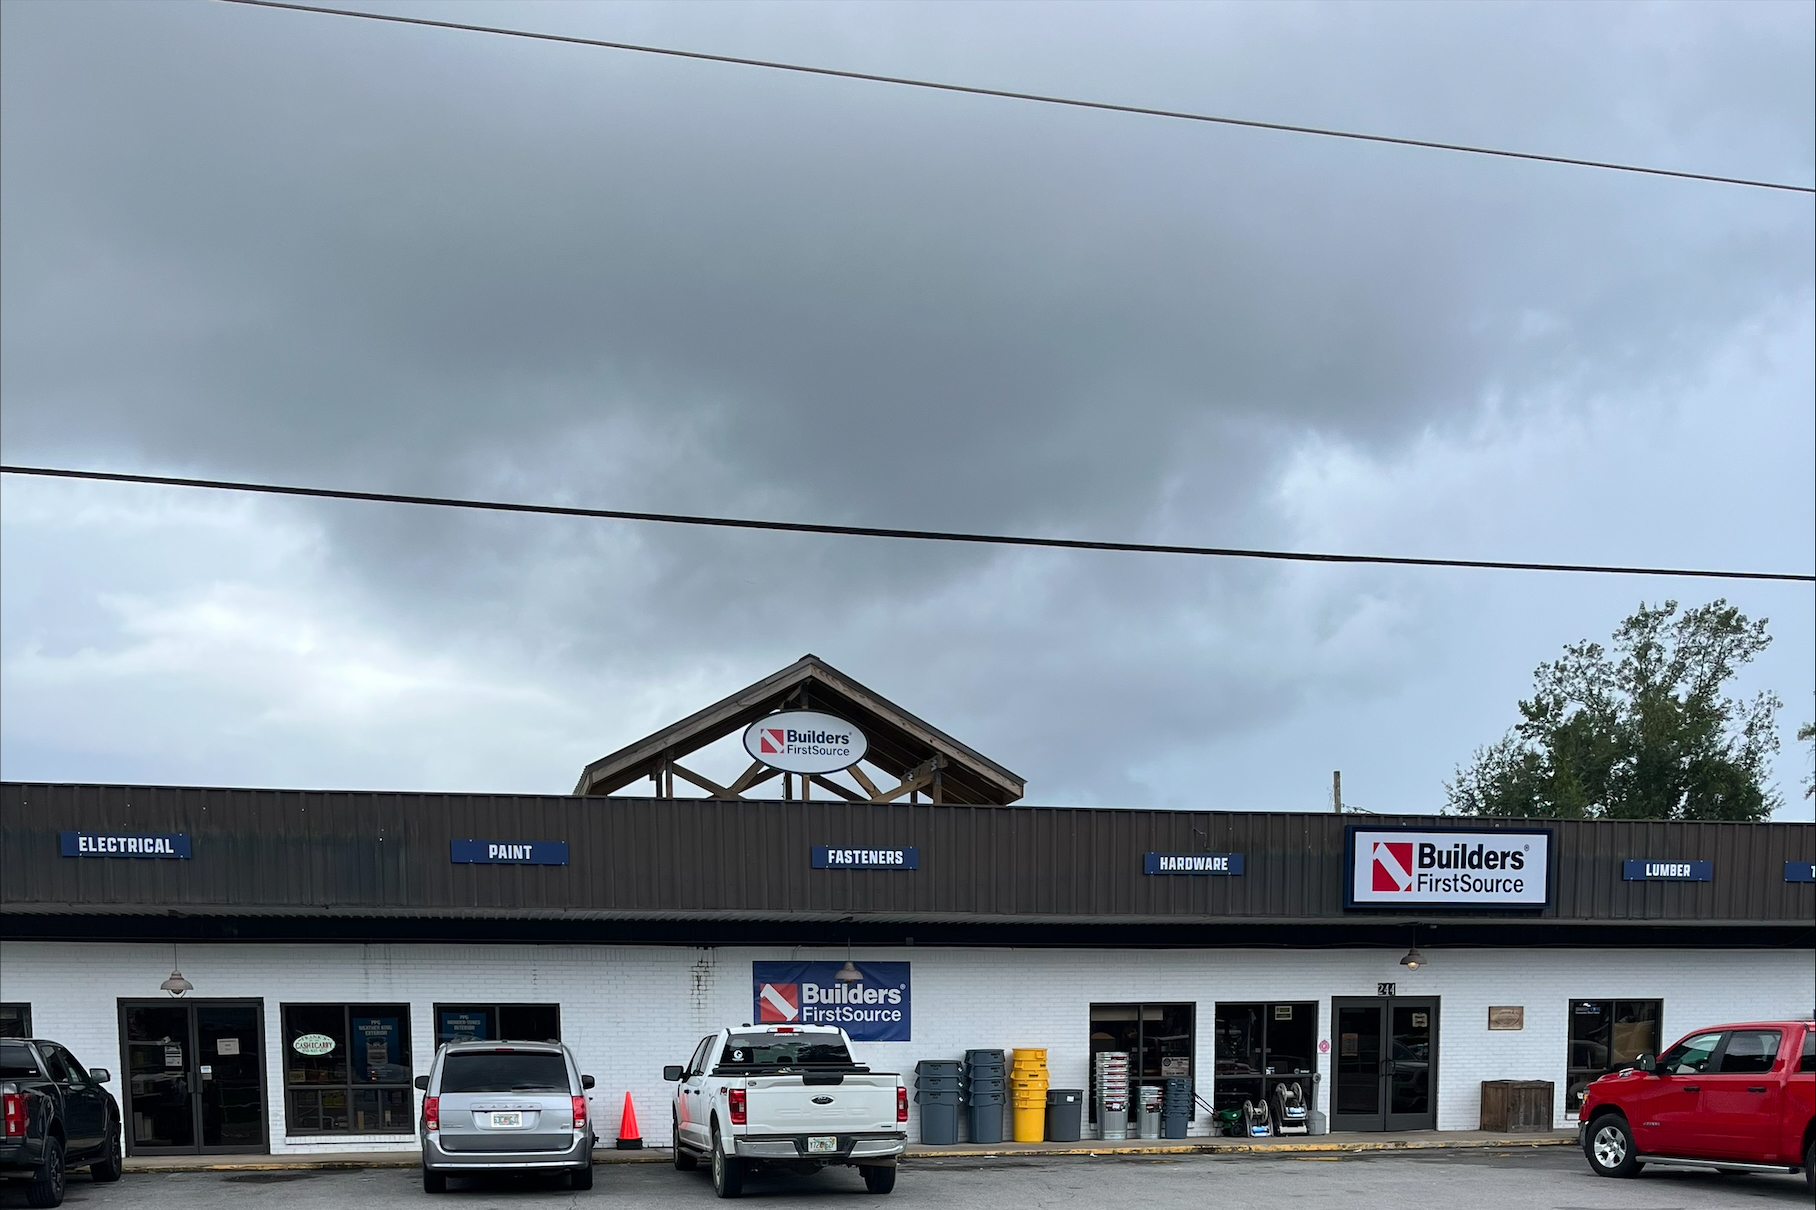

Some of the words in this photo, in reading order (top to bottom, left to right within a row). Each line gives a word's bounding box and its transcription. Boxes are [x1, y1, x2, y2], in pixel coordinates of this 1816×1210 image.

[787, 729, 850, 745] Builders
[787, 745, 850, 756] FirstSource
[78, 836, 175, 854] ELECTRICAL
[488, 844, 532, 860] PAINT
[828, 849, 904, 865] FASTENERS
[1160, 856, 1229, 871] HARDWARE
[1418, 842, 1525, 870] Builders
[1645, 863, 1691, 877] LUMBER
[1417, 873, 1525, 893] FirstSource
[802, 983, 902, 1004] Builders
[1378, 983, 1395, 995] 244
[803, 1006, 902, 1022] FirstSource
